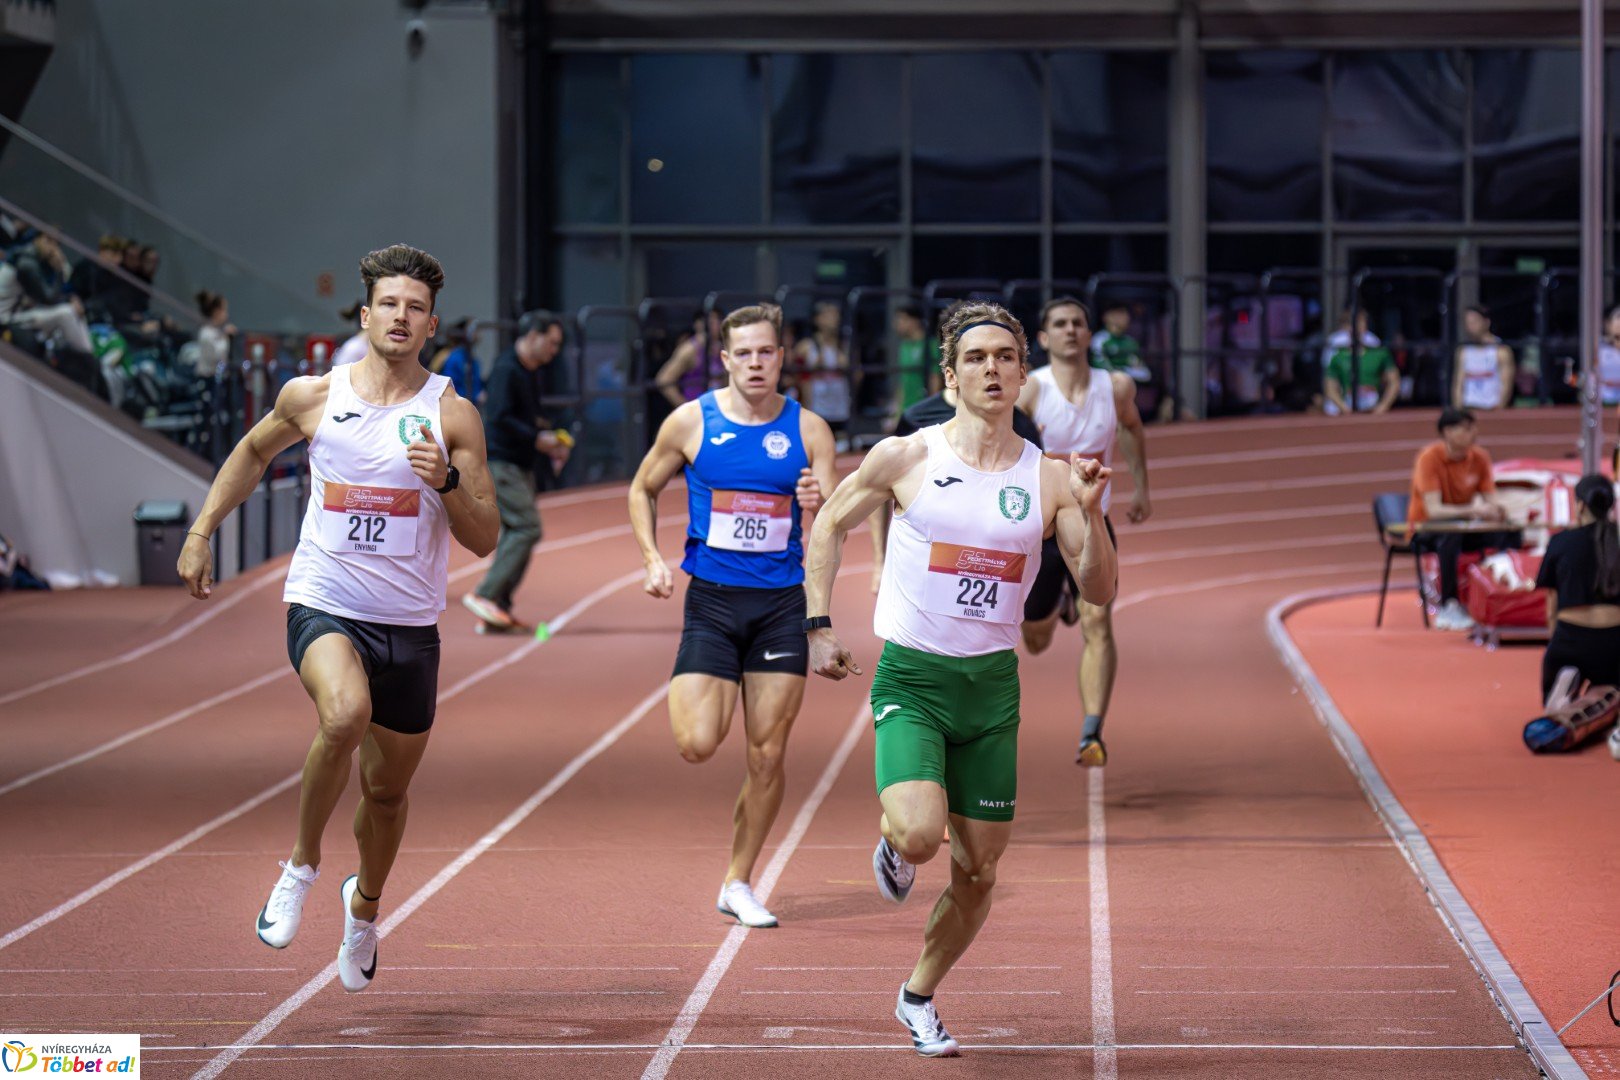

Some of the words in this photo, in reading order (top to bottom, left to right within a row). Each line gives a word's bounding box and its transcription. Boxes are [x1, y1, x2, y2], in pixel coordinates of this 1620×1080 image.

[348, 515, 386, 542] 212
[733, 517, 767, 540] 265
[354, 543, 377, 552] ENYINGI
[956, 578, 999, 609] 224
[963, 607, 986, 618] KOVÁCS
